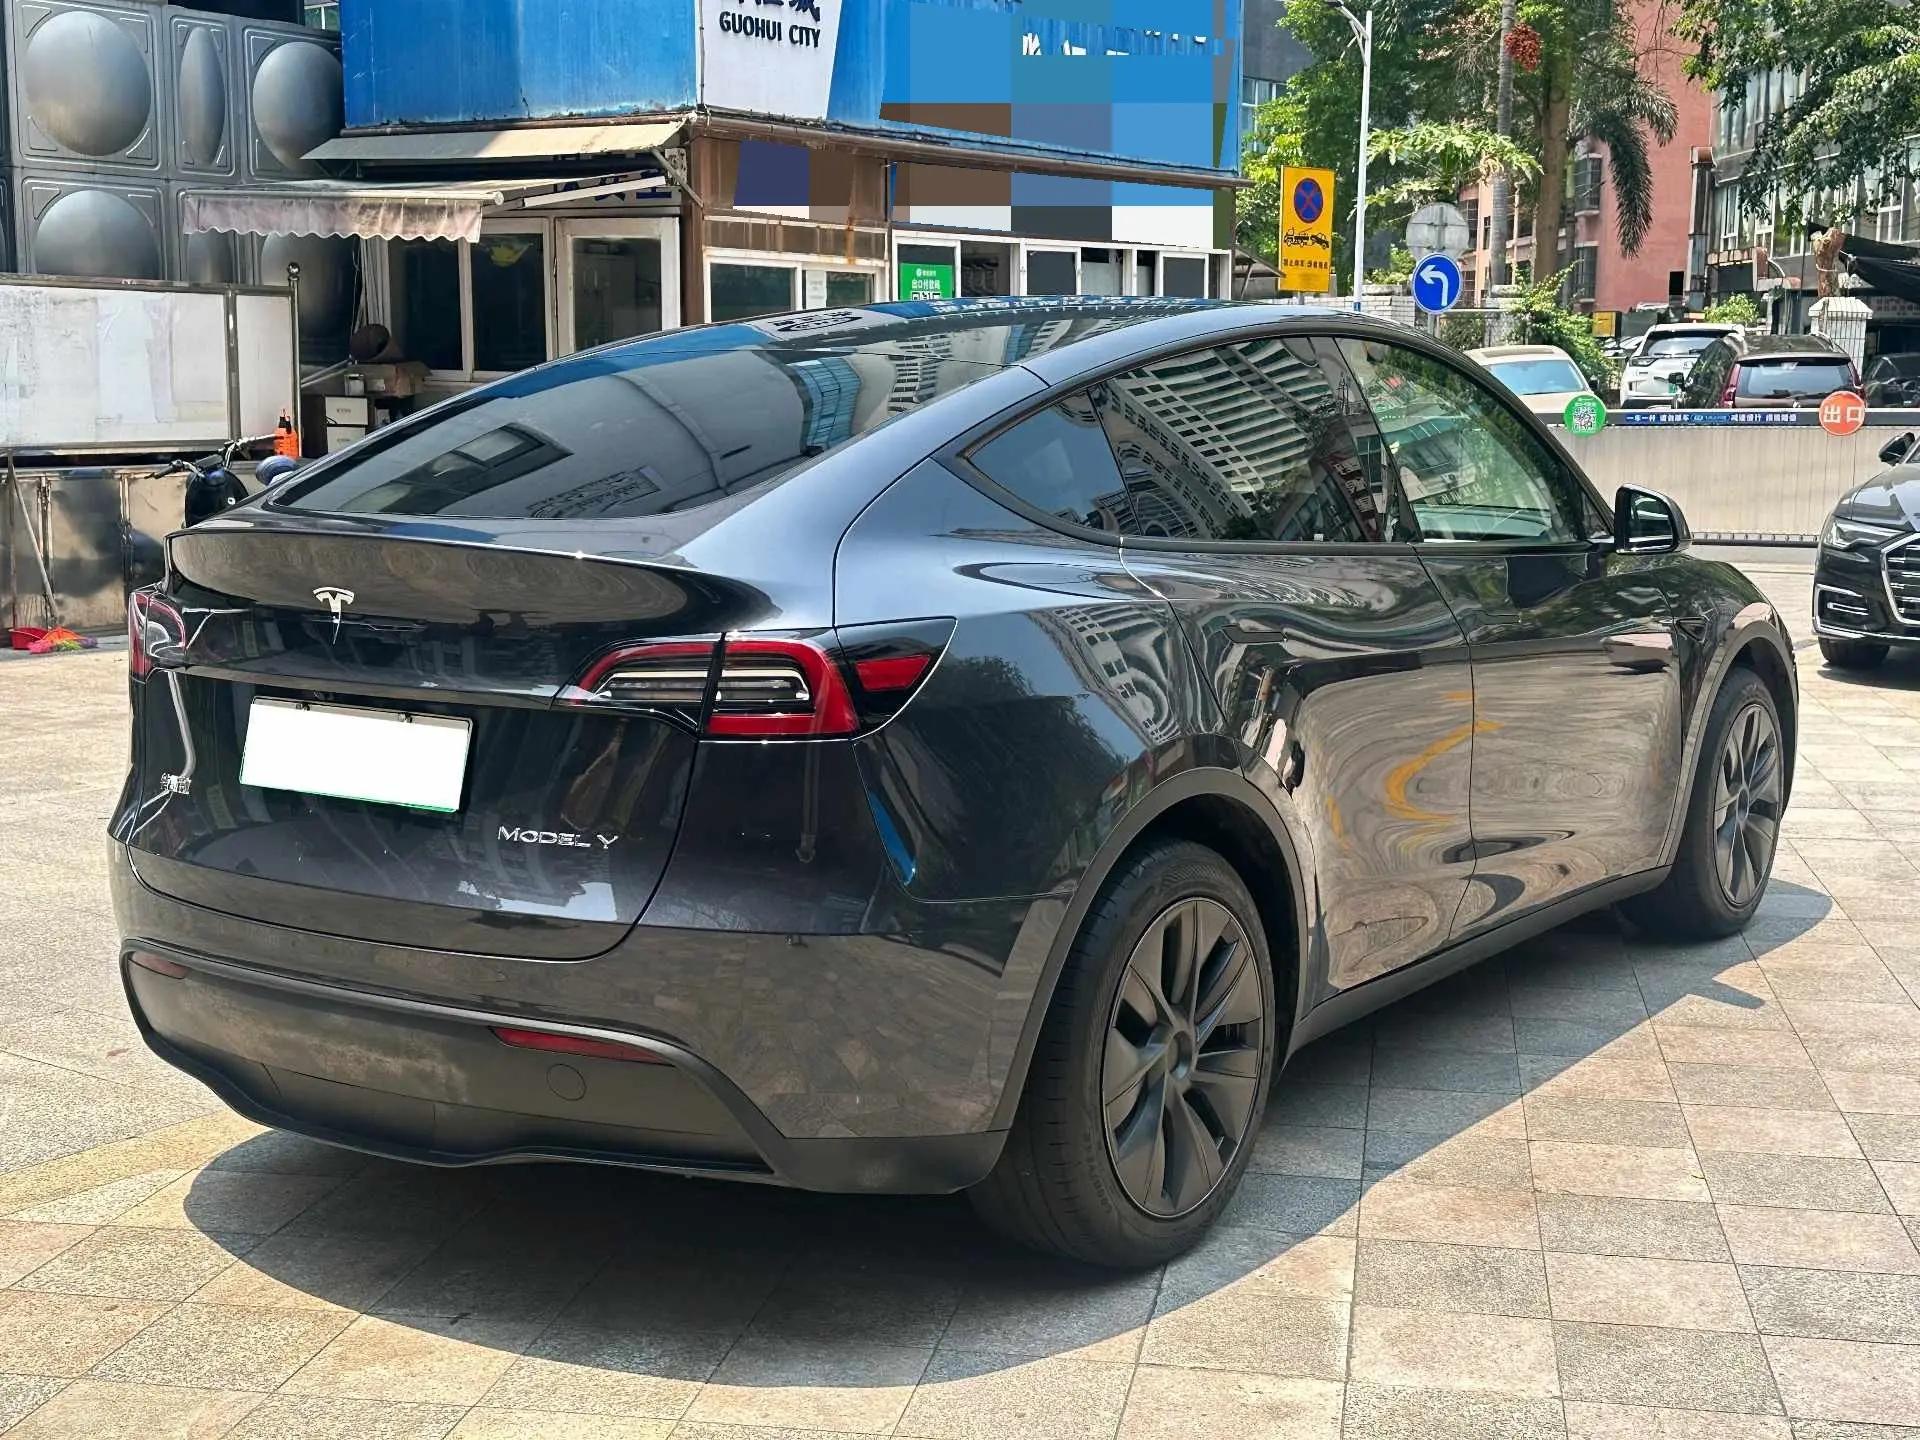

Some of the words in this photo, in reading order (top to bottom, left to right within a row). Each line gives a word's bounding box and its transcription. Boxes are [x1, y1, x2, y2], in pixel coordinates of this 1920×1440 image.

[719, 11, 782, 42] GUOHUI
[788, 24, 821, 49] CITY
[1823, 404, 1864, 424] 出口
[497, 825, 592, 848] MODEL
[596, 833, 619, 849] Y
